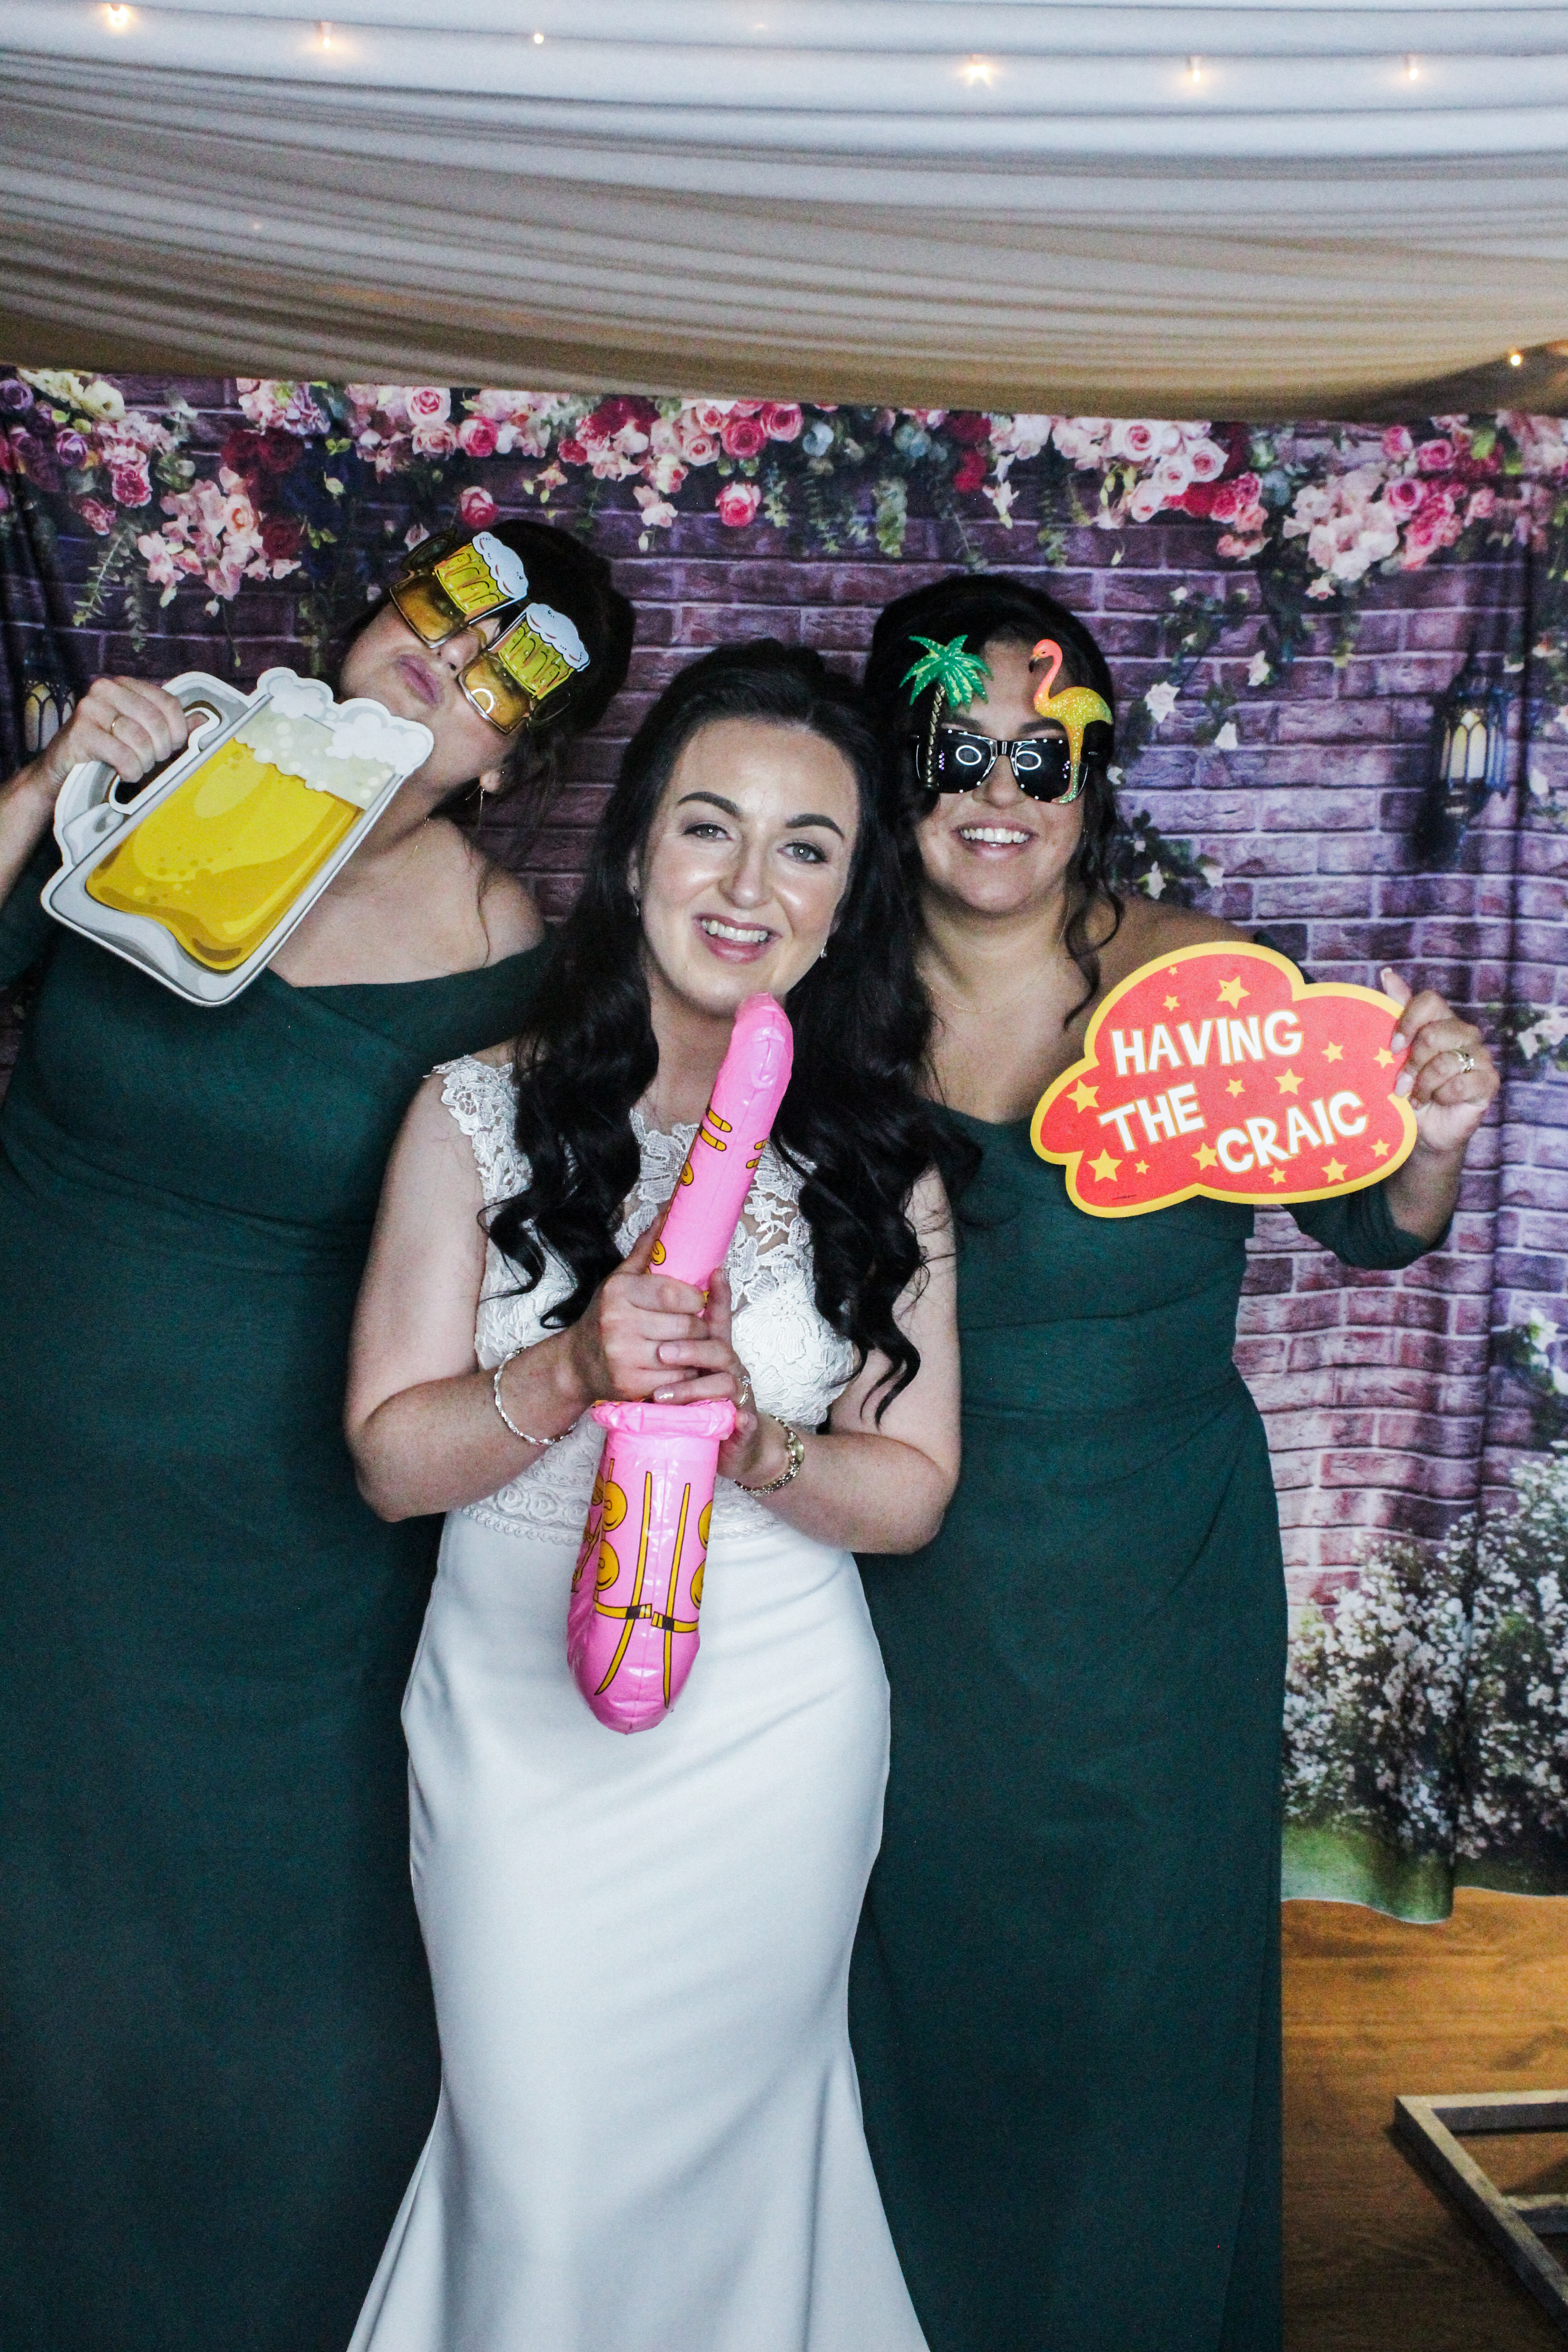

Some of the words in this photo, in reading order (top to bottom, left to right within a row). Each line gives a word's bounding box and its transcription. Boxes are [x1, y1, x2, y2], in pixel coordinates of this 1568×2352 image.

[1112, 1010, 1303, 1075] HAVING
[1099, 1083, 1205, 1152] THE
[1216, 1091, 1367, 1173] CRAIC
